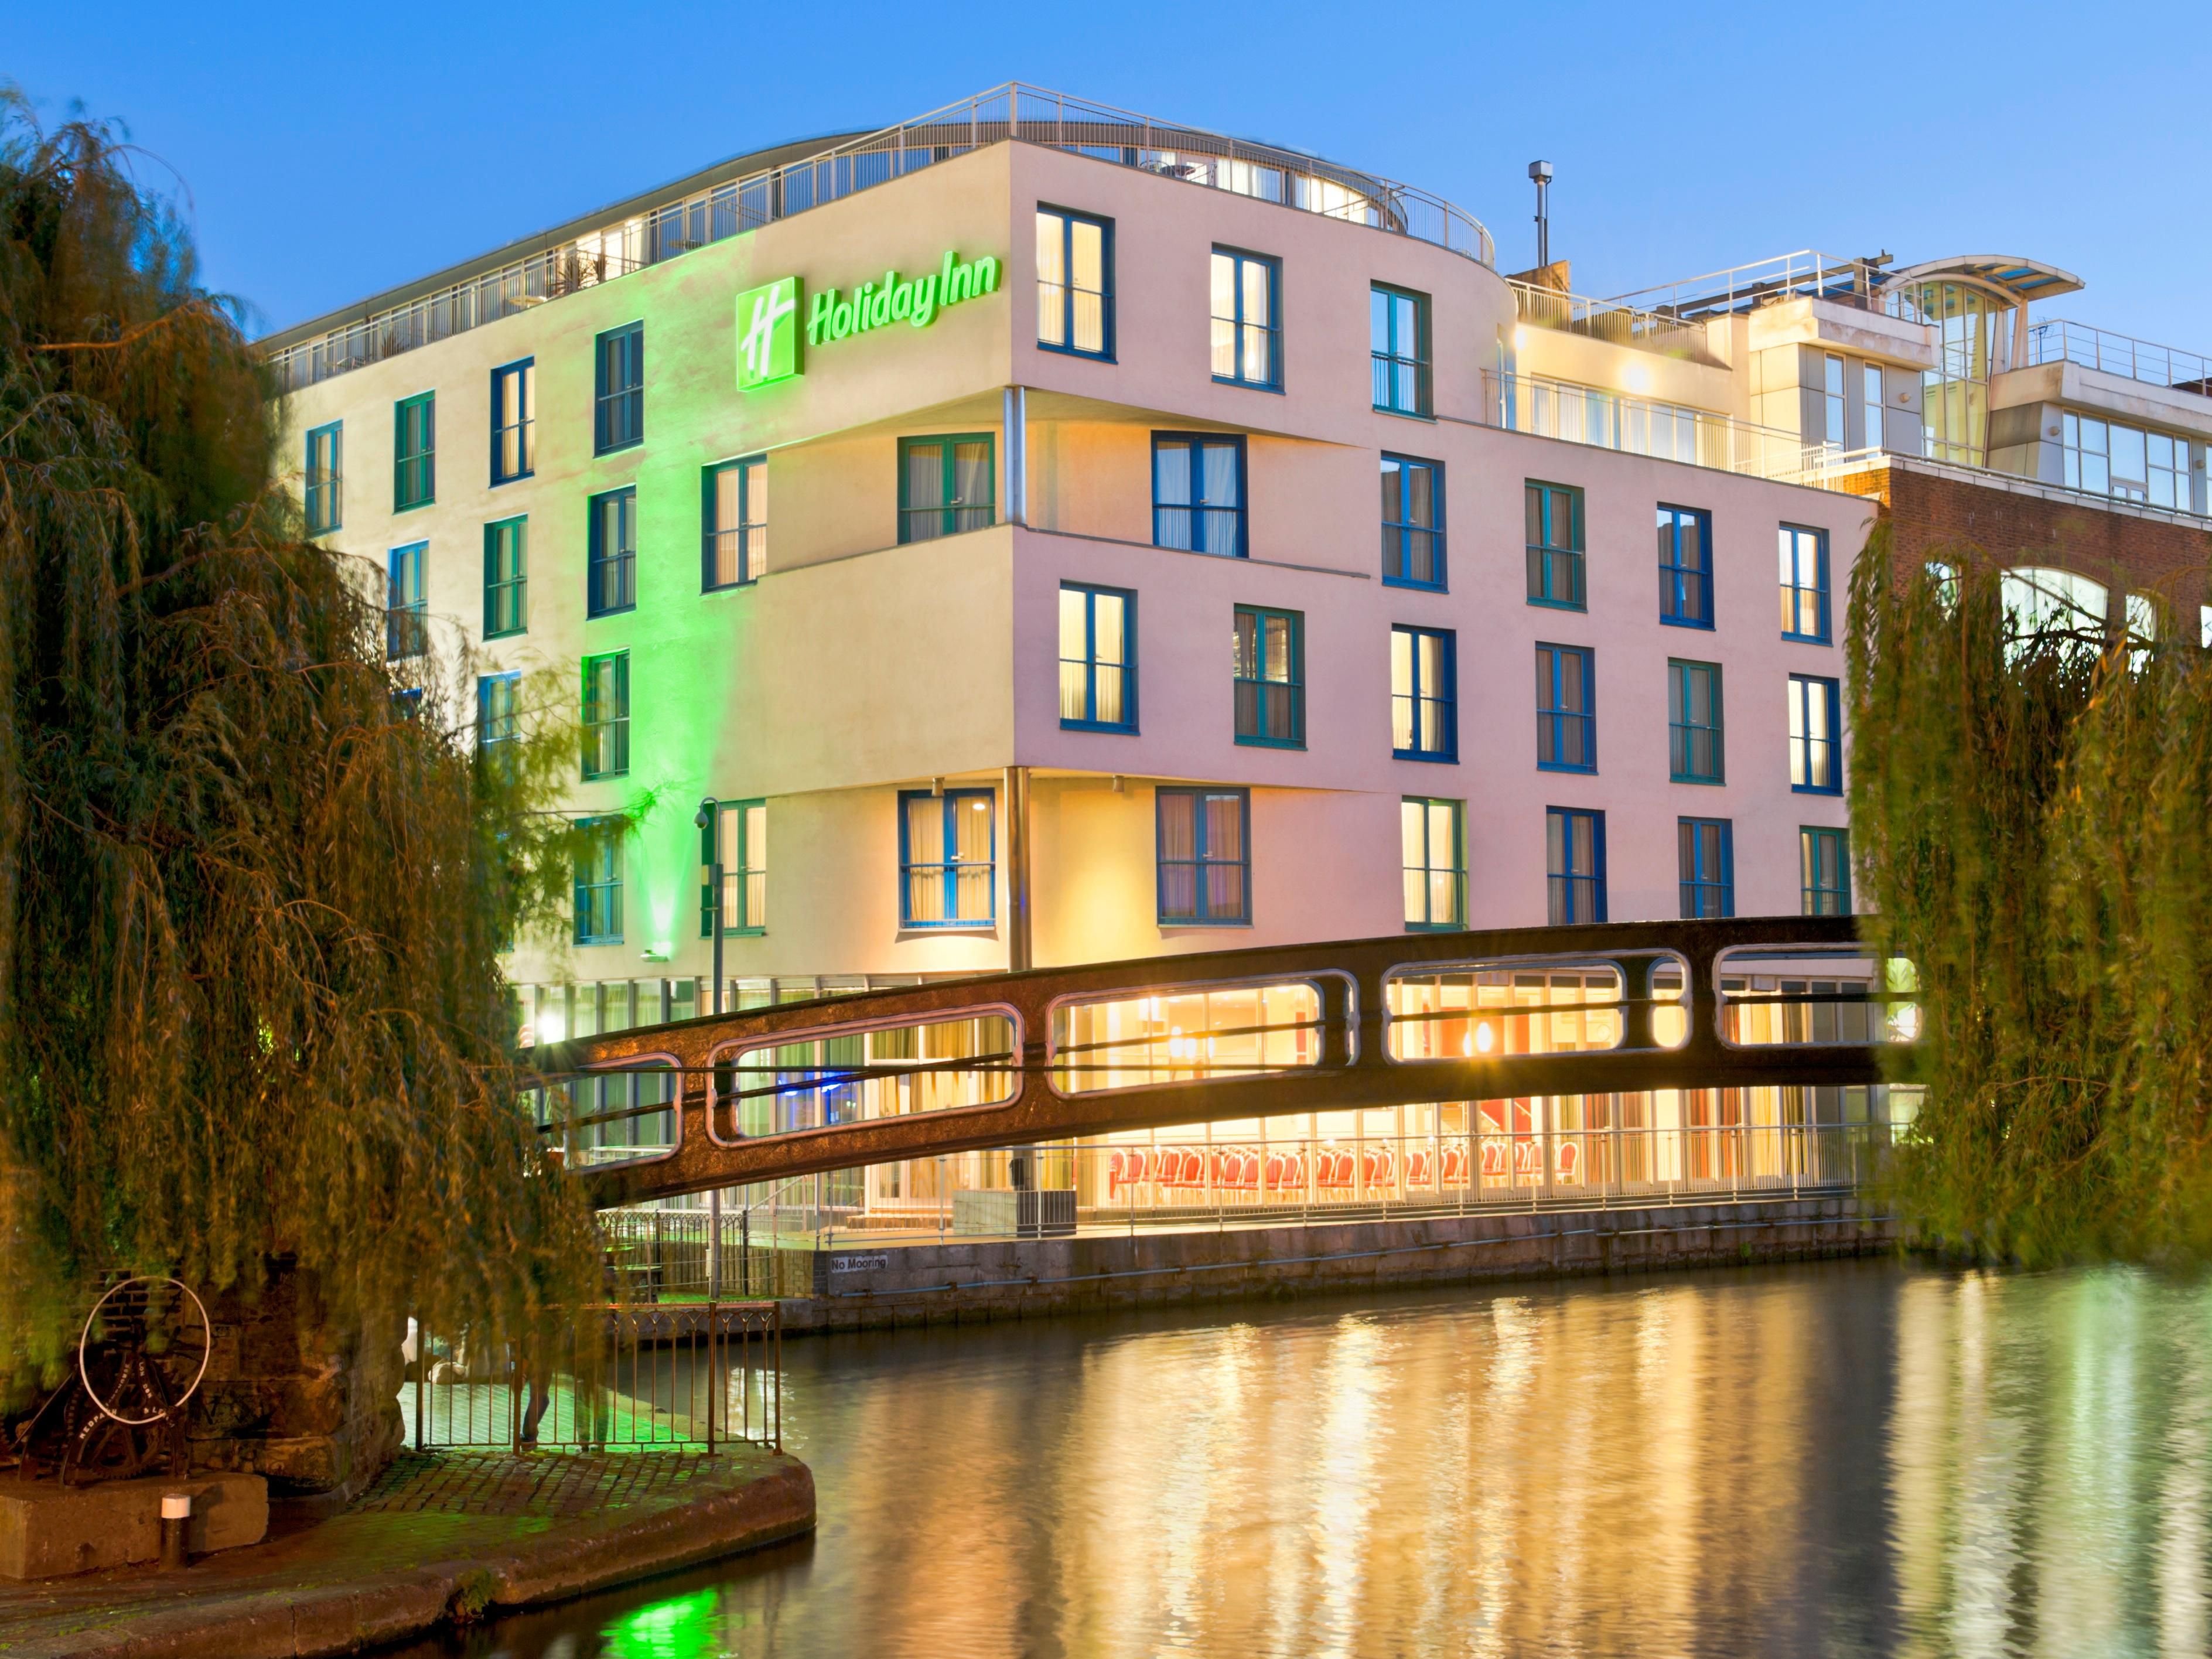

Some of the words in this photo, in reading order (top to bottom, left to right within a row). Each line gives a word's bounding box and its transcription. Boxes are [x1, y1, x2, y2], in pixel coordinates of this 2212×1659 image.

[807, 271, 939, 345] Holiday
[939, 251, 999, 306] Inn
[832, 1259, 845, 1270] No
[848, 1258, 886, 1269] Mooring
[80, 1409, 117, 1439] REDPAH
